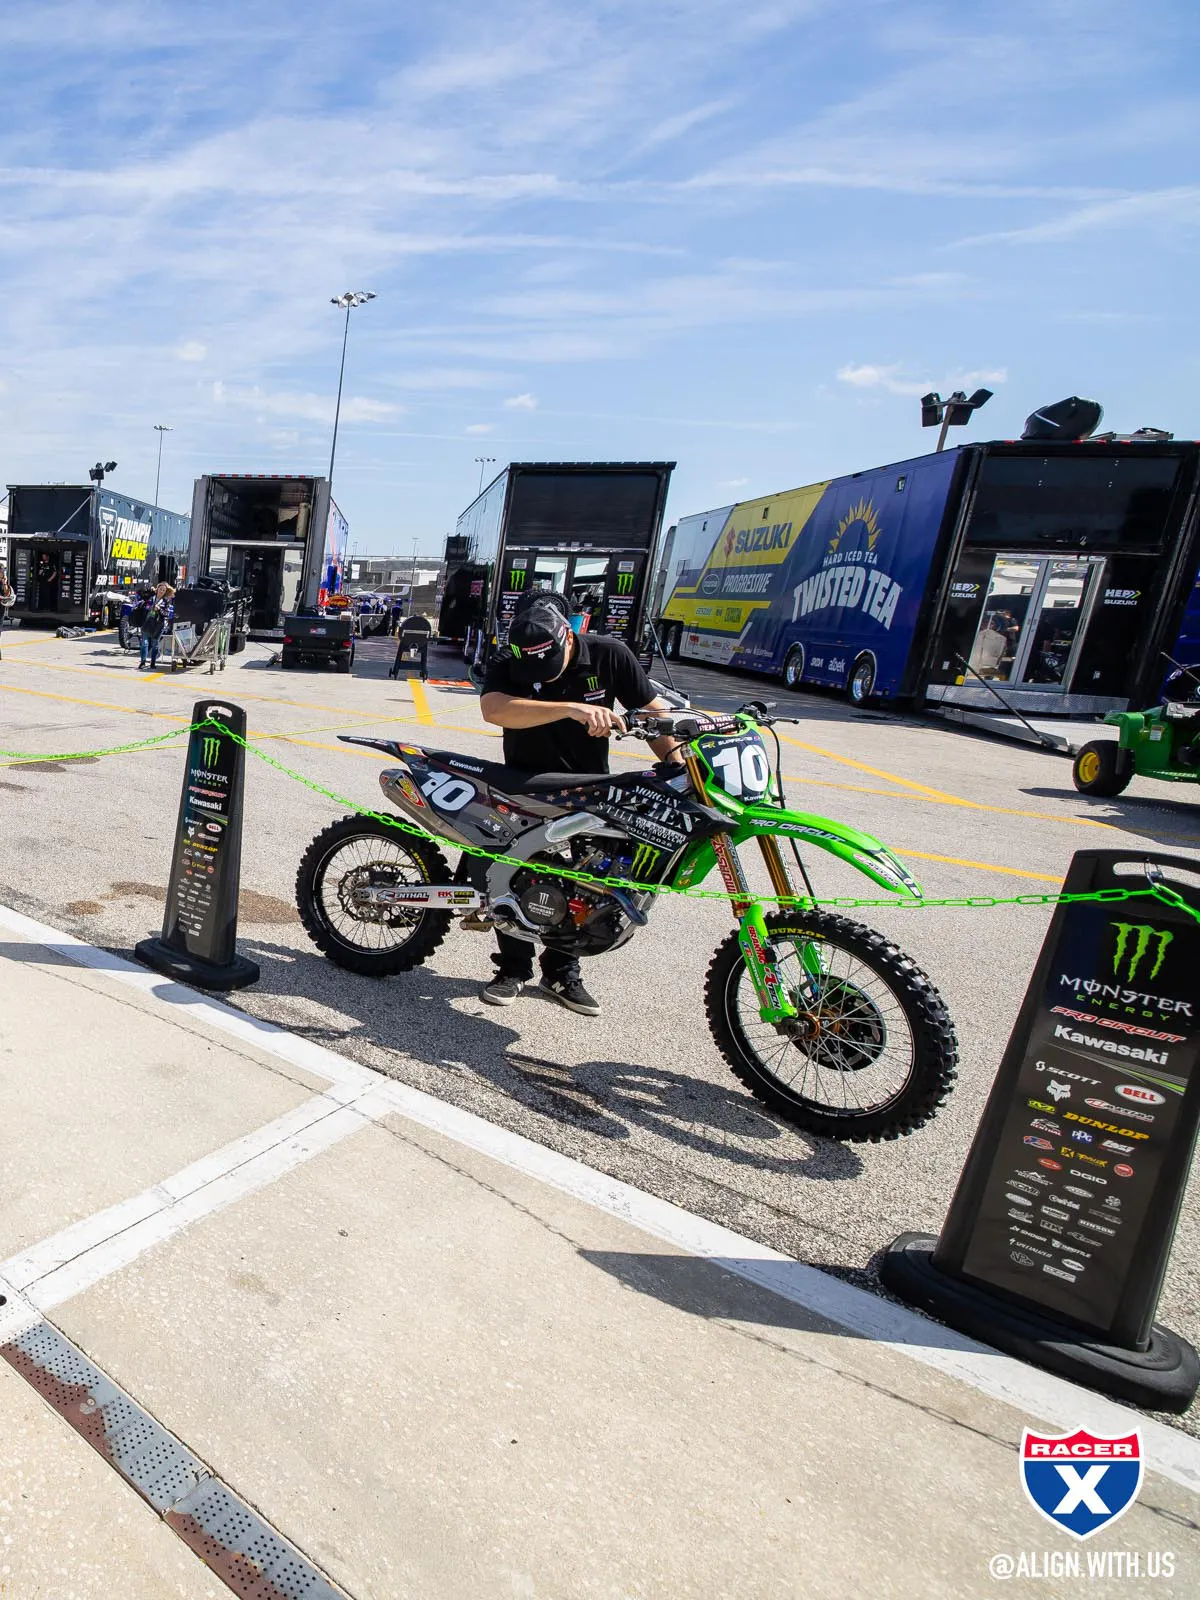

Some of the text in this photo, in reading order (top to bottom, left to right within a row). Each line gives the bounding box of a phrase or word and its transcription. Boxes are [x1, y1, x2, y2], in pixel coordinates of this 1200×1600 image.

[115, 517, 151, 543] TRIUMPH
[735, 522, 792, 554] SUZUKI
[112, 538, 147, 560] RACING
[823, 551, 878, 567] HARD ICED TEA
[721, 573, 773, 593] PROGRESSIVE
[792, 567, 903, 631] TWISTED TEA
[191, 769, 228, 784] MONSTER
[449, 760, 483, 773] Kawasaki
[712, 745, 769, 796] 10
[190, 796, 222, 810] Kawasaki
[421, 772, 475, 811] 10
[632, 785, 681, 809] MORGAN
[749, 819, 849, 844] PRO CIRCUIT
[769, 927, 826, 939] DUNLOP
[1060, 974, 1193, 1017] MONSTER
[1076, 994, 1170, 1021] ENERGY
[1050, 1005, 1187, 1043] PRO CIRCUIT
[1054, 1024, 1169, 1065] Kawasaki
[1046, 1066, 1102, 1086] SCOTT
[1123, 1087, 1157, 1102] BELL
[1063, 1111, 1150, 1141] DUNLOP
[1072, 1129, 1093, 1142] PPG
[1070, 1169, 1108, 1185] OGIO
